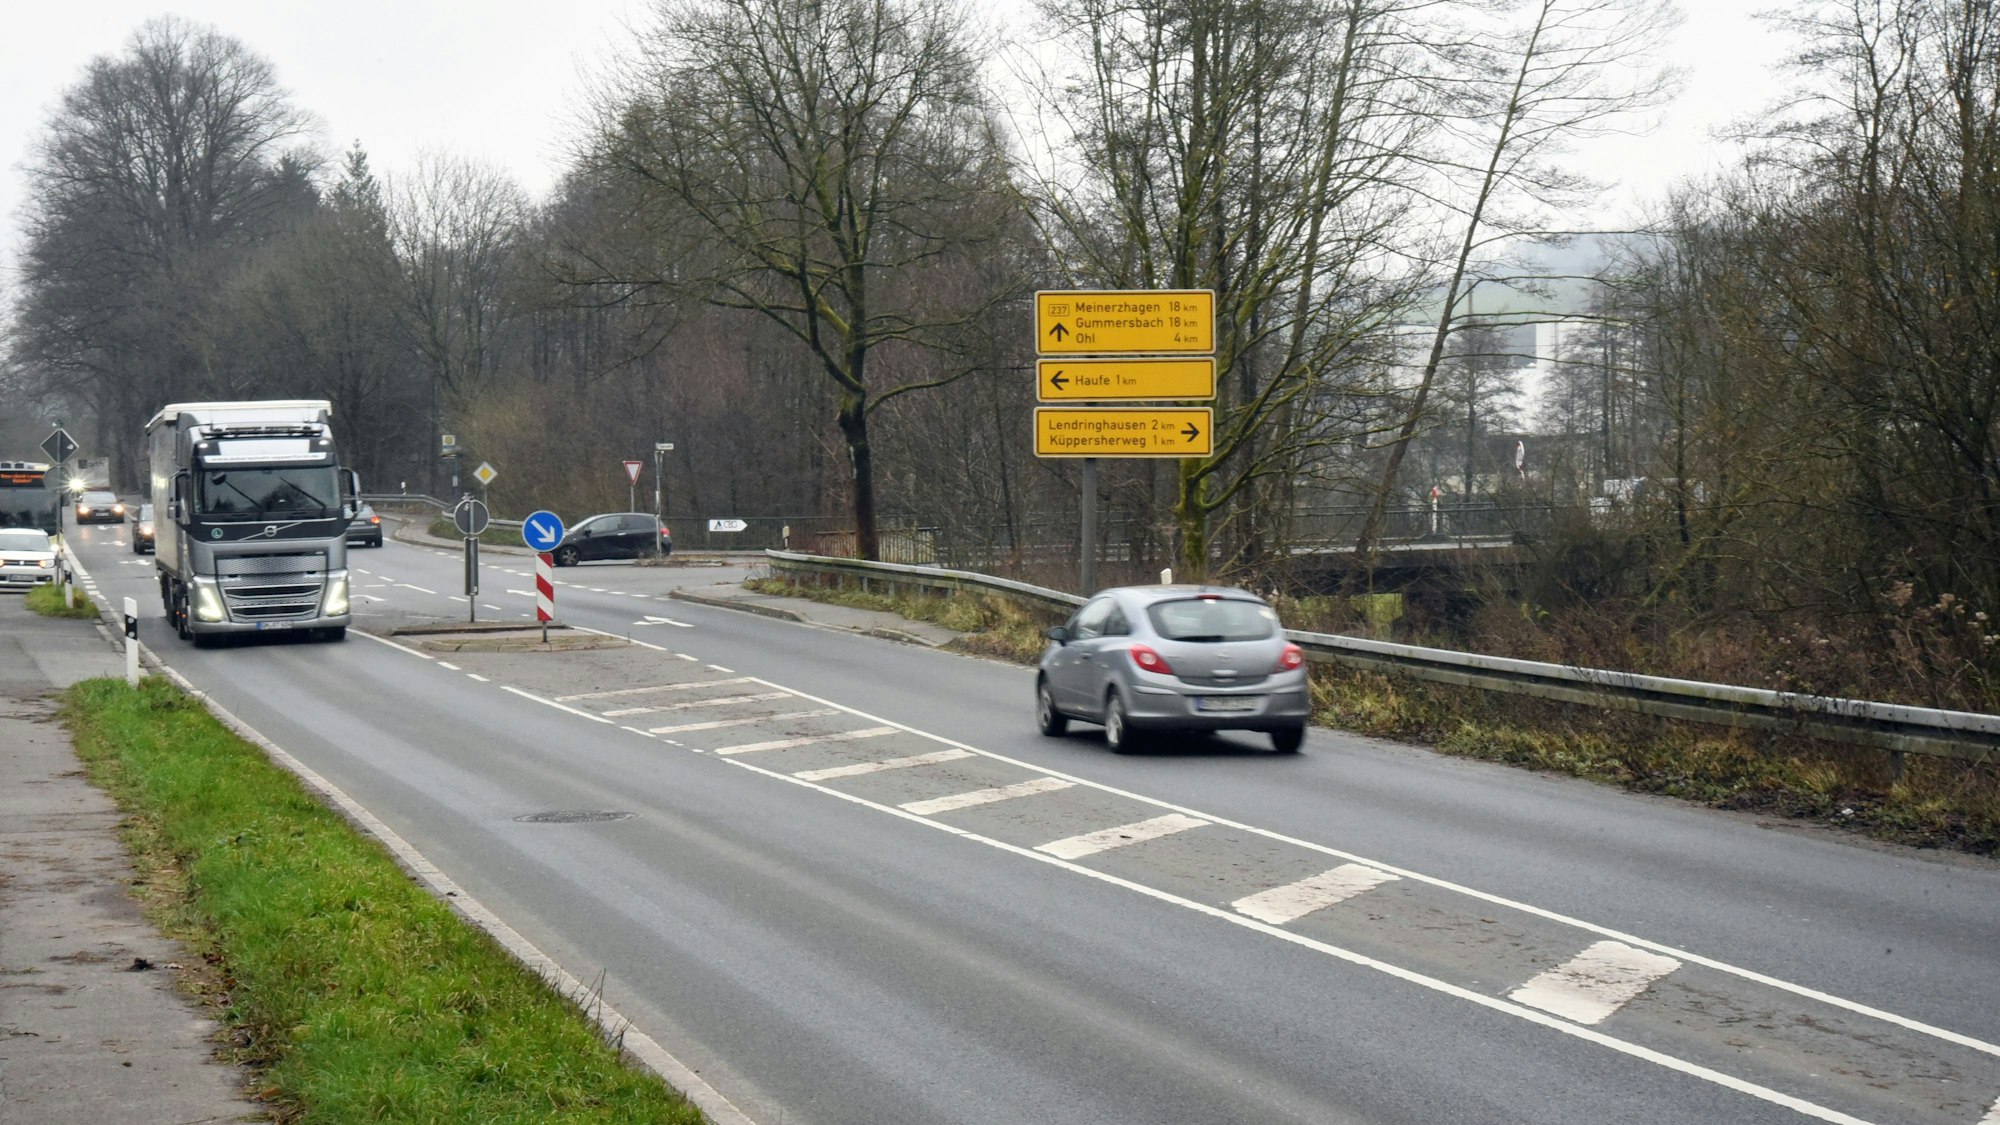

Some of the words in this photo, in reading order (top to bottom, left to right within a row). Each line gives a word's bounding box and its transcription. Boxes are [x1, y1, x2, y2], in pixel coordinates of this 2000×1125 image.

[1050, 306, 1067, 315] 237
[1075, 301, 1160, 315] Meinerzhagen
[1169, 301, 1181, 312] 18
[1183, 304, 1198, 312] km
[1075, 317, 1164, 328] Gummersbach
[1169, 317, 1181, 328] 18
[1183, 319, 1198, 328] km
[1075, 333, 1096, 344] Ohl
[1173, 333, 1181, 343] 4
[1183, 335, 1198, 343] km
[1075, 375, 1111, 386] Haufe
[1122, 377, 1137, 385] km
[1049, 419, 1147, 432] Lendringhausen
[1151, 419, 1159, 430] 2
[1161, 422, 1175, 430] km
[1050, 434, 1147, 448] Küppersherweg
[1161, 437, 1175, 446] km
